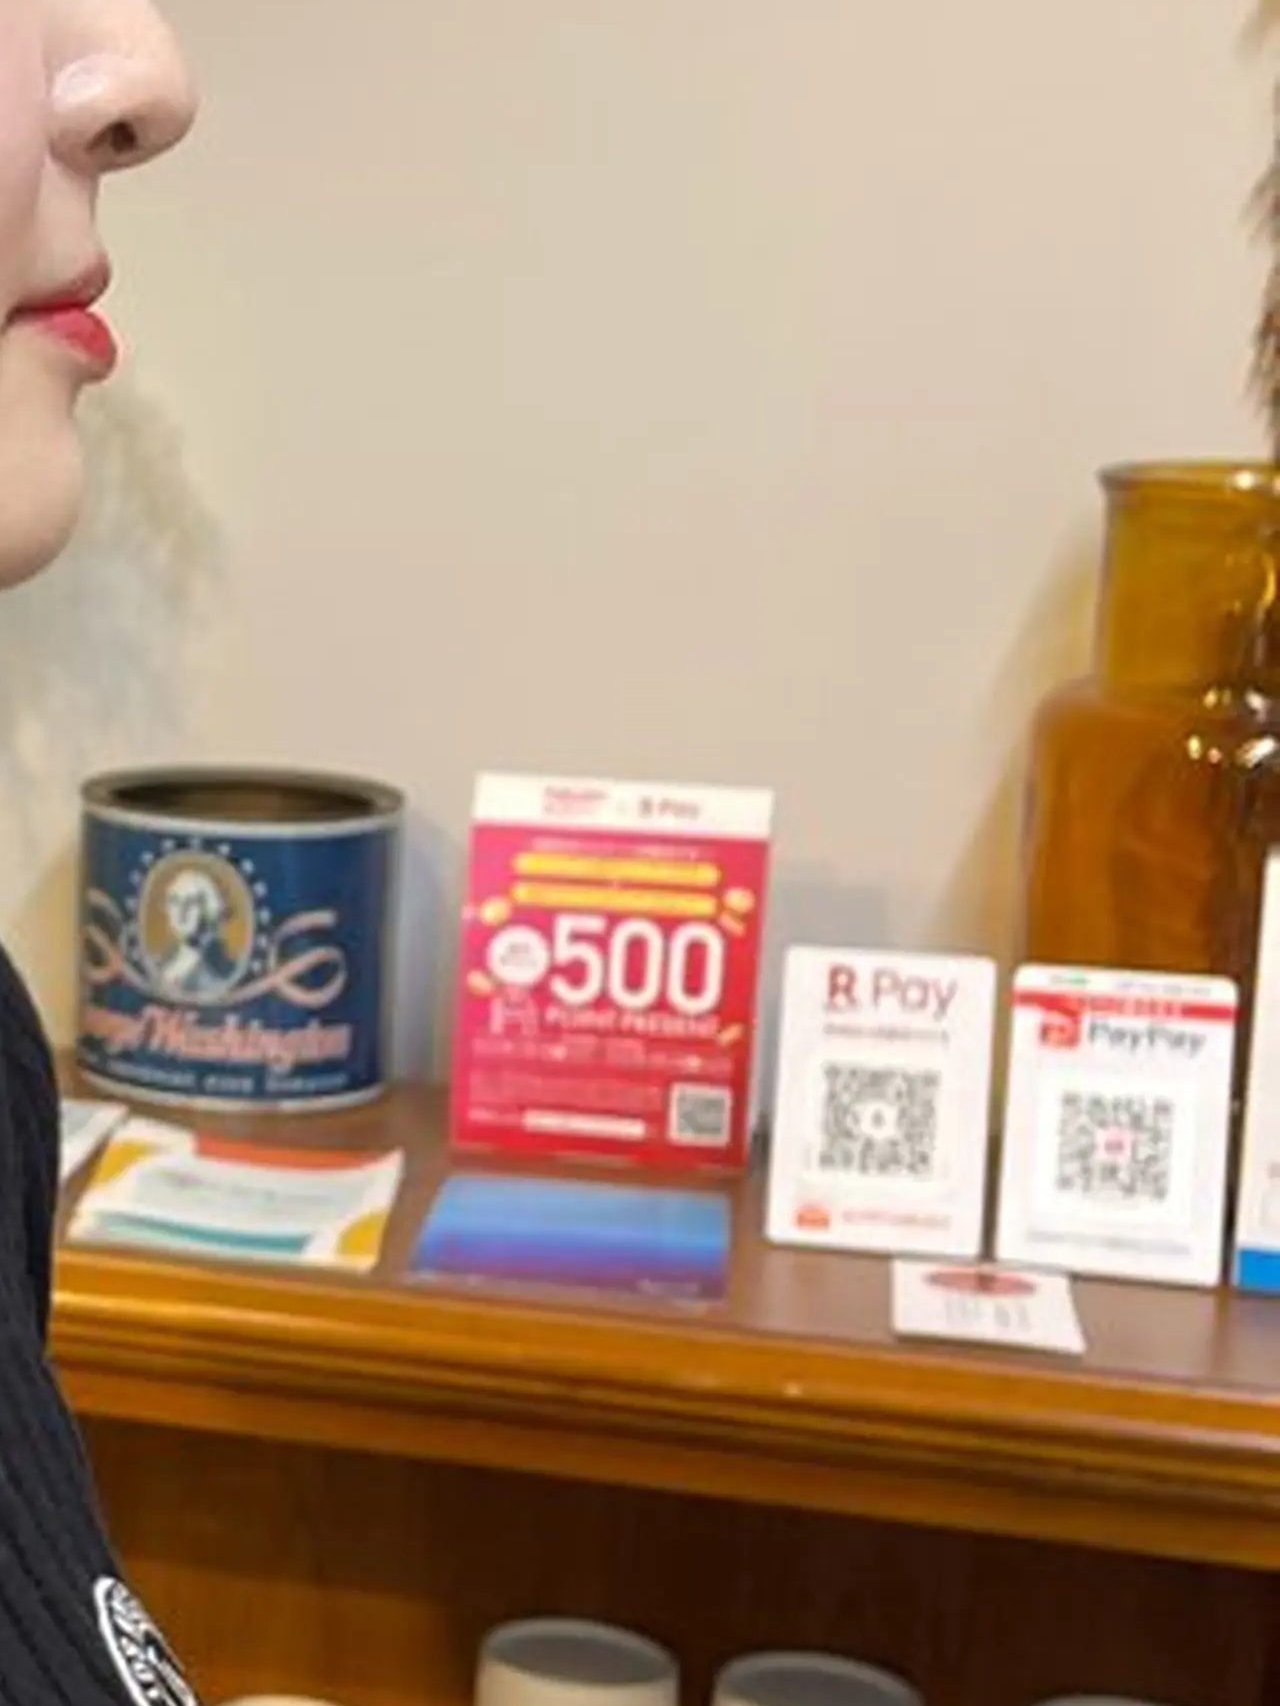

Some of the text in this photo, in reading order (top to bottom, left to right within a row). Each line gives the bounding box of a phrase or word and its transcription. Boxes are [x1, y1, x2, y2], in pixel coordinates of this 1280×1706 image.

[550, 913, 725, 1017] 500
[825, 962, 959, 1022] R Pay
[1087, 1021, 1209, 1060] PayPay
